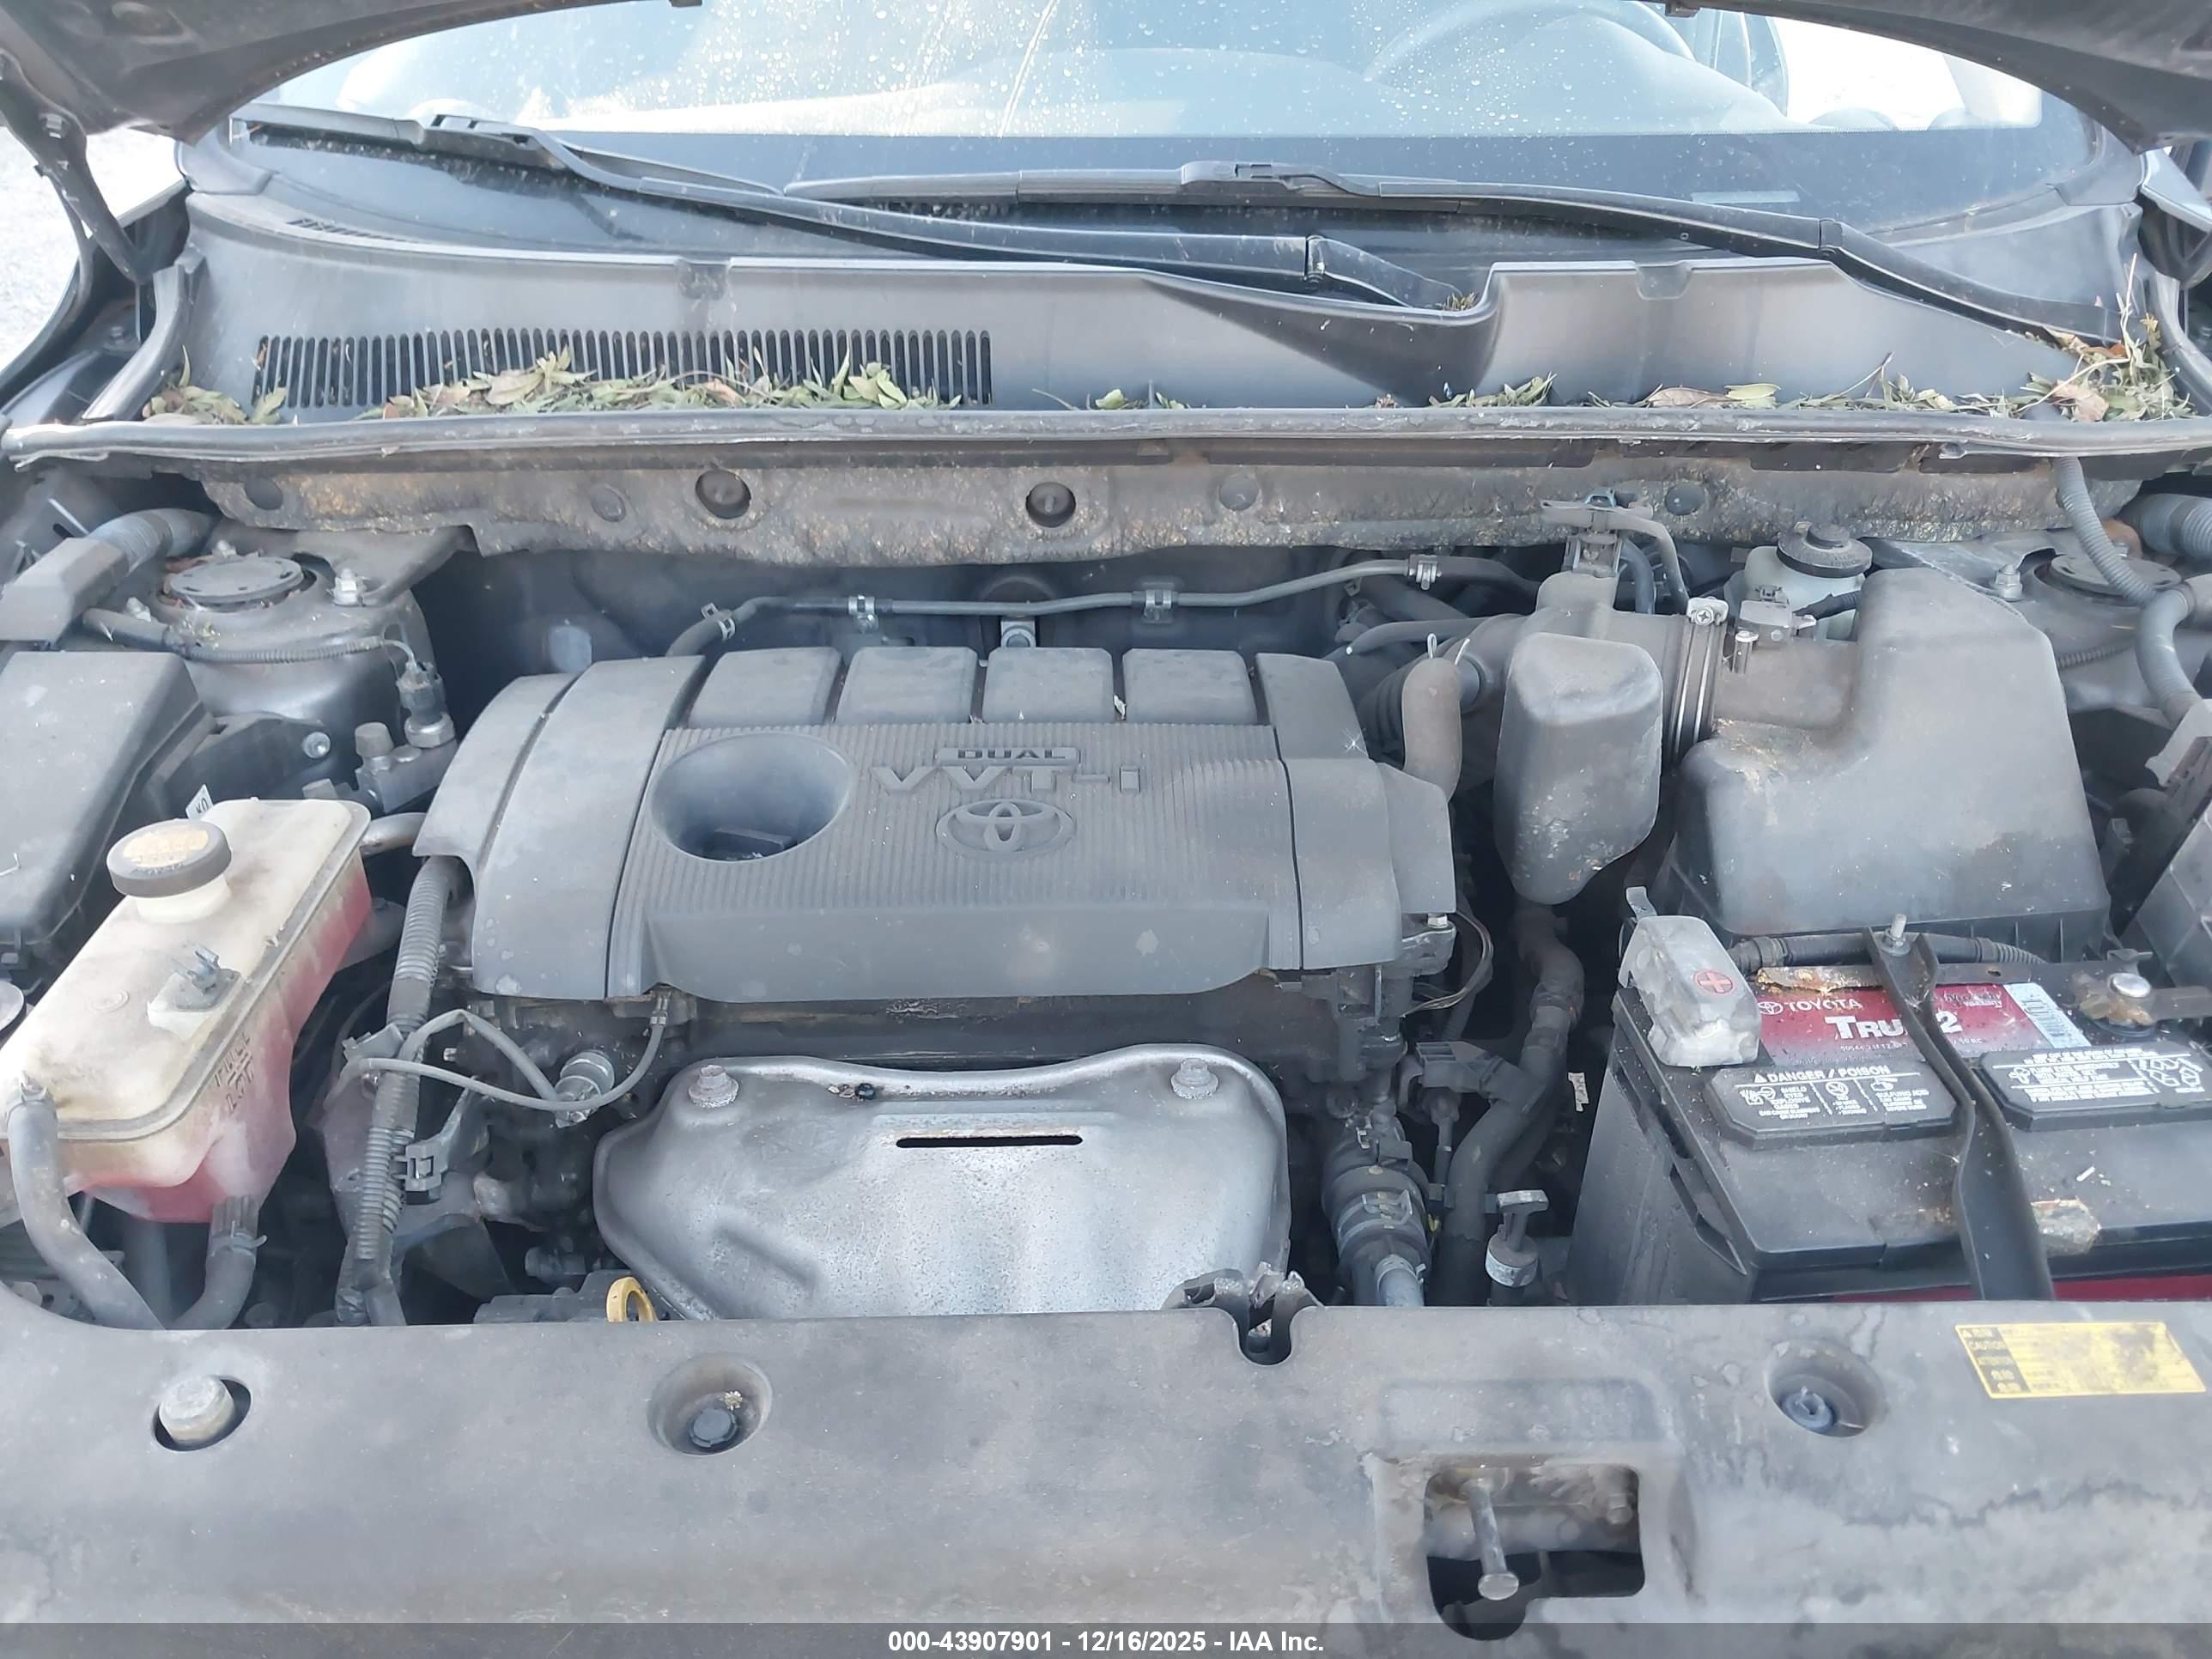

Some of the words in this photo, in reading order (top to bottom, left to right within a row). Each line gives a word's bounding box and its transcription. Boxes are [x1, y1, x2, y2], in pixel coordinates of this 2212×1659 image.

[957, 749, 1066, 760] DUAL
[1785, 997, 1863, 1012] TOYOTA
[1766, 1069, 1826, 1084] DANGER
[1839, 1064, 1892, 1078] POISON
